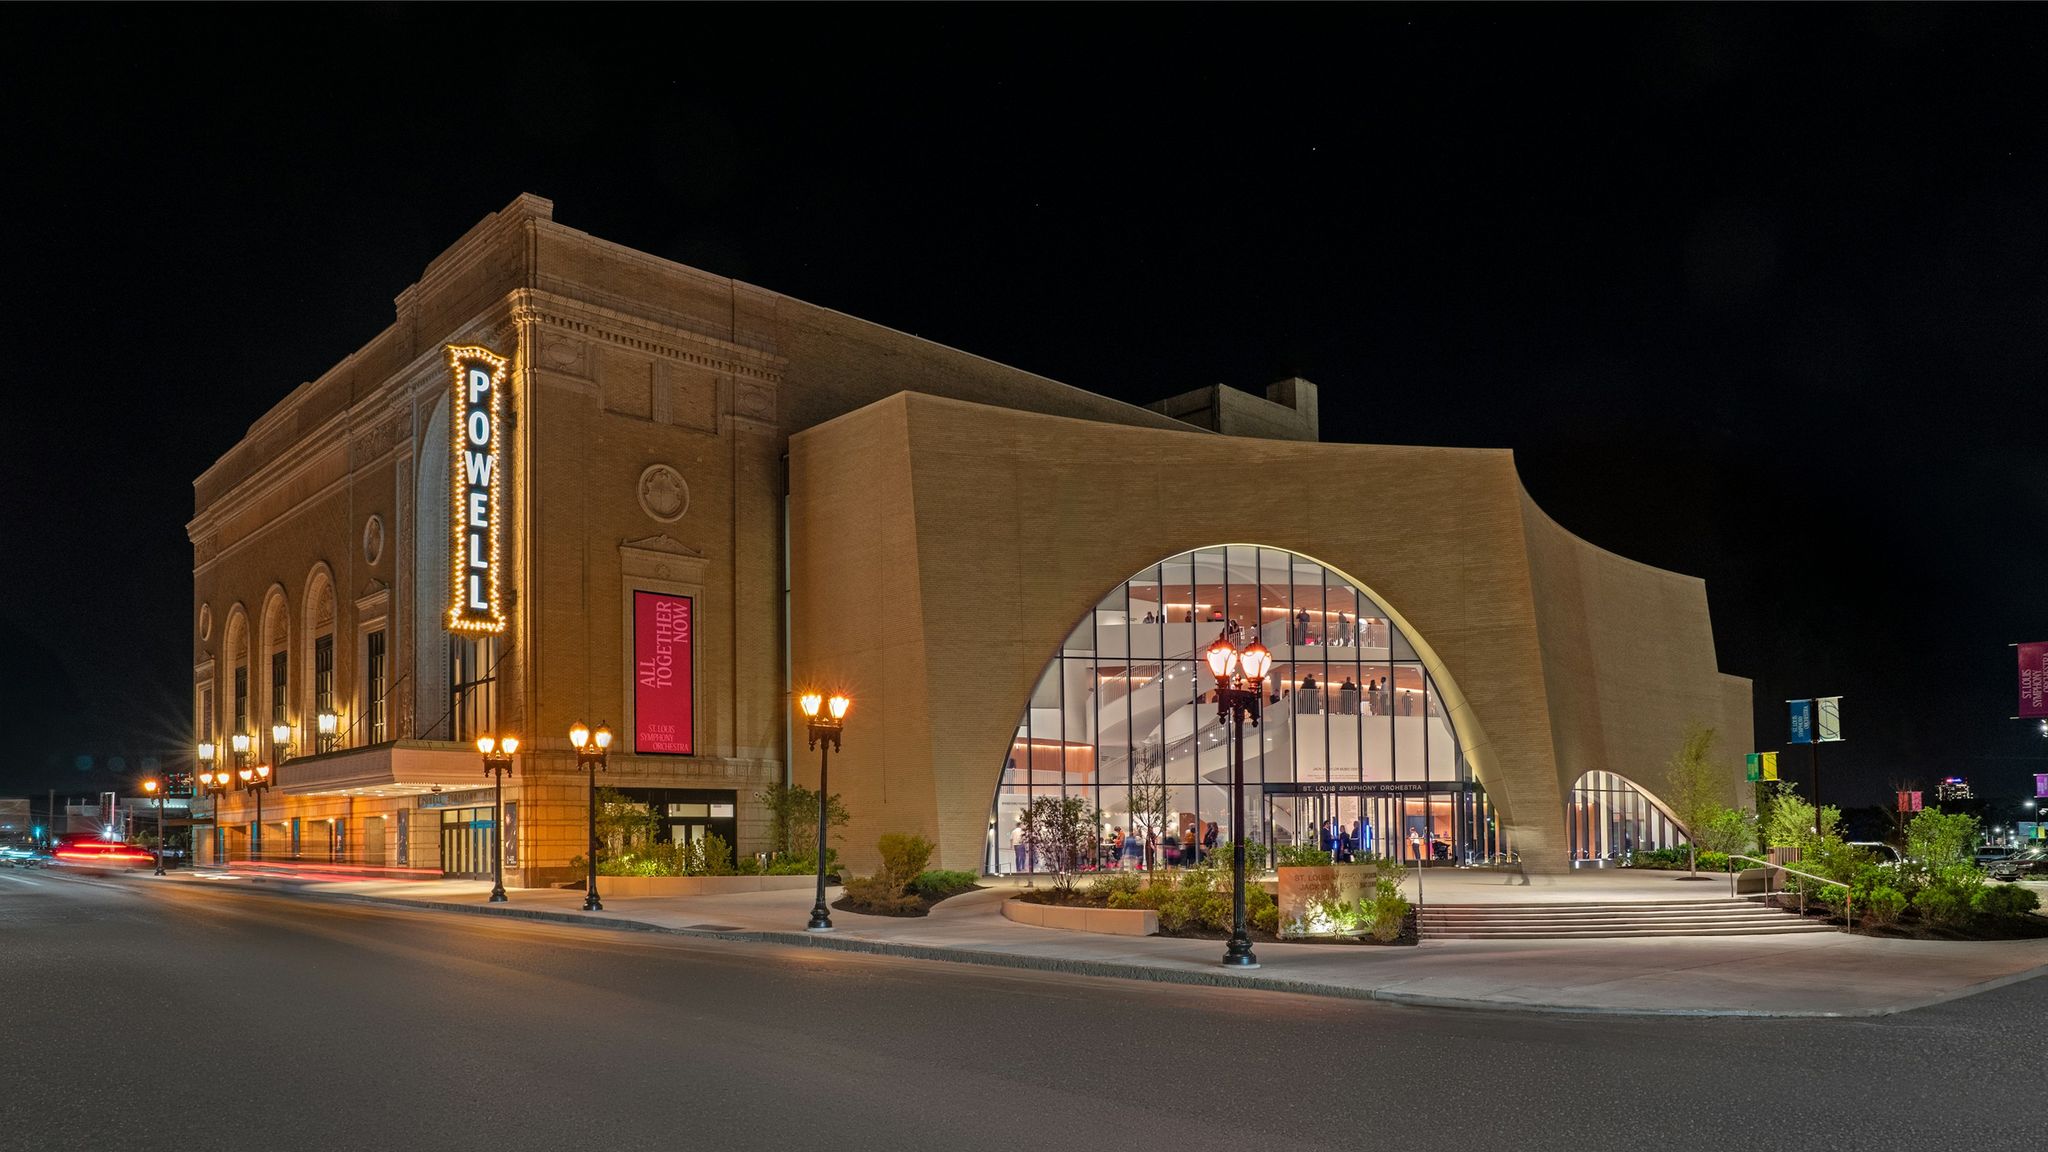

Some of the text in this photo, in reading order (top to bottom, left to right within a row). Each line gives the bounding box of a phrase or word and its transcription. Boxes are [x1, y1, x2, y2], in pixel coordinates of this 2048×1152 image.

[464, 369, 493, 610] POWELL
[673, 602, 688, 643] NOW
[656, 601, 673, 689] TOGETHER
[640, 657, 656, 689] ALL
[2022, 669, 2032, 688] LOUIS
[2032, 670, 2042, 708] SYMPHONY
[640, 732, 674, 741] SYMPHONY
[658, 725, 675, 733] LOUIS
[652, 742, 689, 751] ORCHESTRA
